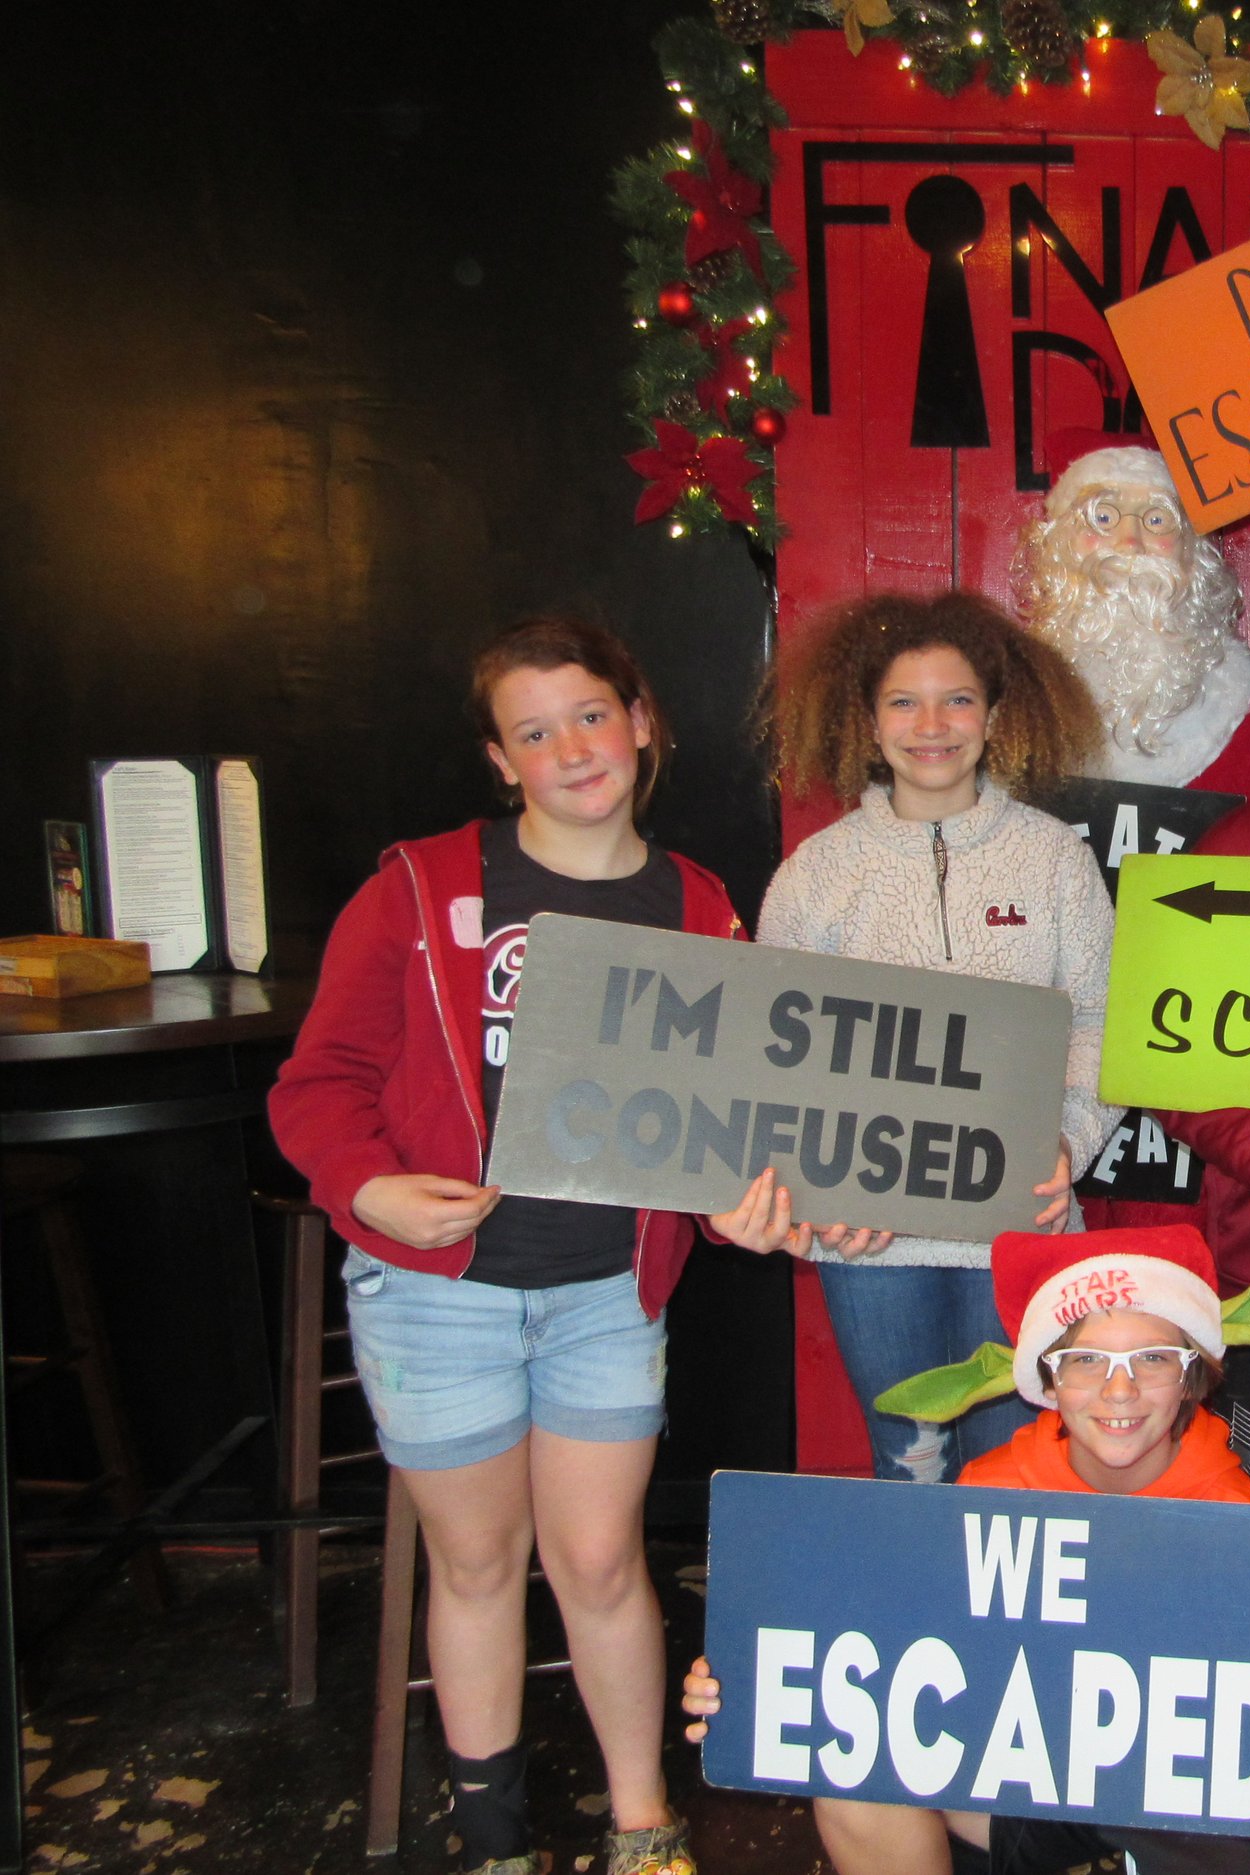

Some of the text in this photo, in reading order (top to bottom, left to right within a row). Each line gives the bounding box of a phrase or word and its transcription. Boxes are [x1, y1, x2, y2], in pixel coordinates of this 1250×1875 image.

[599, 966, 723, 1057] I'M
[764, 990, 982, 1091] STILL
[546, 1079, 1006, 1203] CONFUSED
[964, 1513, 1090, 1624] WE
